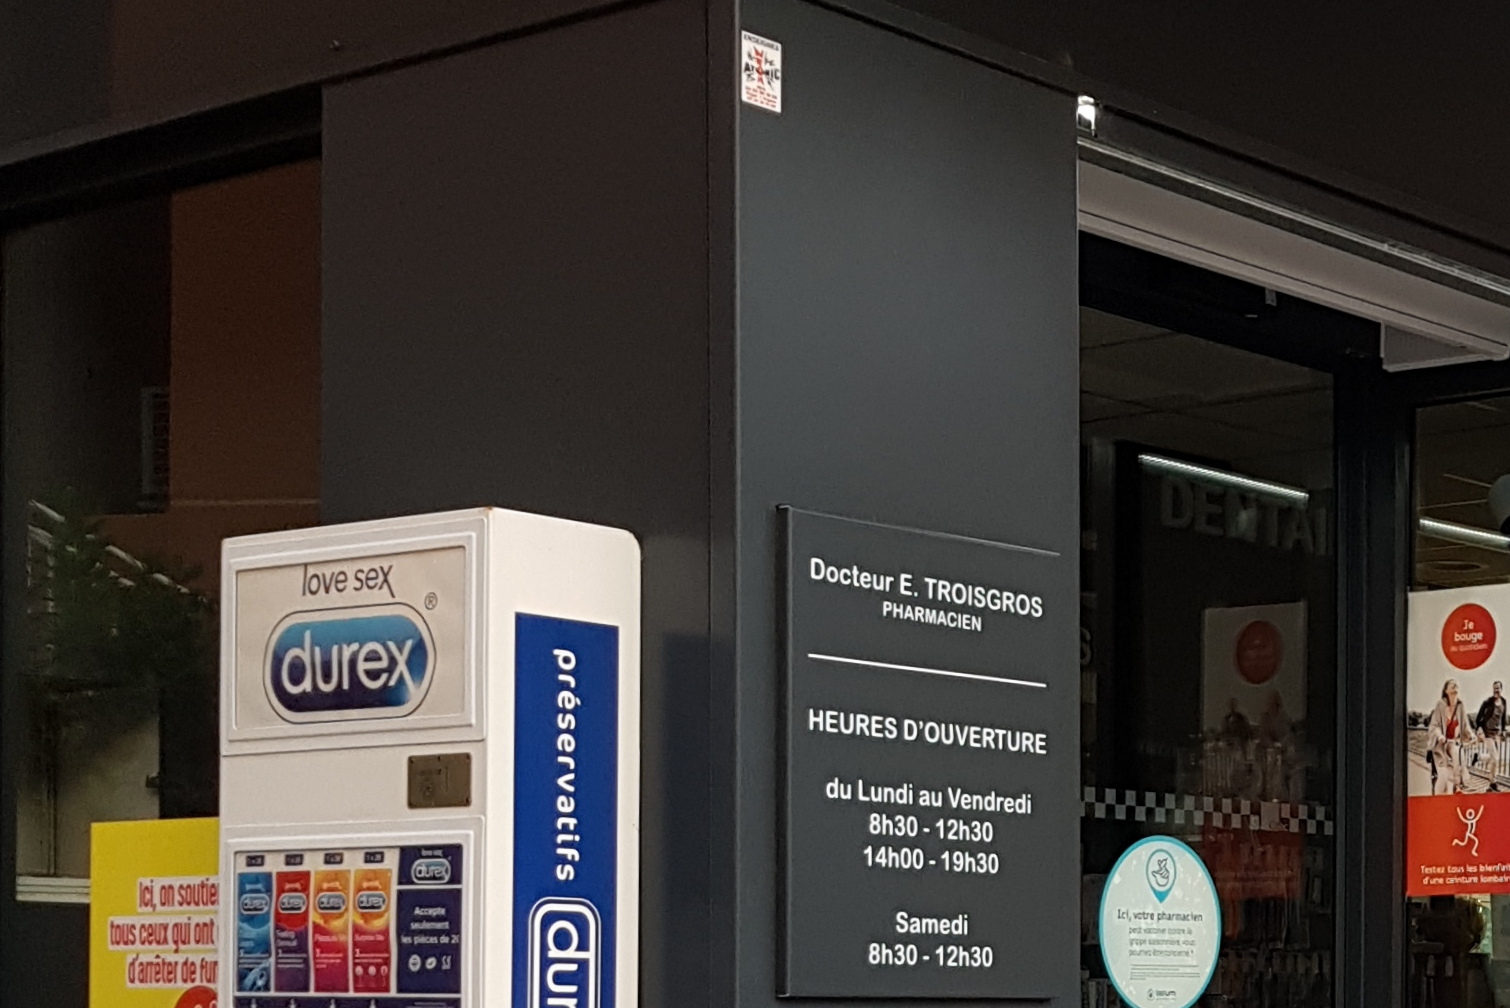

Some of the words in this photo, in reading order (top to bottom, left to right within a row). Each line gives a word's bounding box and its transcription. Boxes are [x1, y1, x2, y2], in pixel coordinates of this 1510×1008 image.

[302, 564, 347, 596] love
[354, 564, 396, 598] sex
[810, 557, 894, 592] Docteur
[900, 574, 918, 597] E.
[924, 577, 1043, 618] TROISGROS
[882, 601, 982, 632] PHARMACIEN
[1463, 619, 1474, 630] Je
[1454, 632, 1483, 643] bouge
[281, 629, 420, 695] durex
[809, 709, 897, 739] HEURES
[903, 719, 1047, 754] D'OUVERTURE
[552, 648, 580, 881] préservatifs
[826, 777, 851, 799] du
[858, 779, 913, 805] Lundi
[919, 789, 942, 807] au
[948, 787, 1032, 814] Vendredi
[869, 813, 918, 837] 8h30
[935, 818, 993, 842] 12h30
[415, 865, 449, 880] durex
[863, 845, 924, 870] 14h00
[941, 851, 1000, 874] 19h30
[1421, 865, 1445, 874] Testez
[1466, 864, 1477, 873] les
[139, 880, 156, 911] Ici,
[160, 885, 174, 907] on
[178, 878, 219, 906] soutie
[1423, 876, 1443, 884] d'une
[1446, 876, 1478, 884] ceinture
[411, 921, 449, 929] seulement
[414, 906, 446, 917] Accepte
[895, 911, 968, 935] Samedi
[1117, 909, 1132, 922] Ici,
[1133, 911, 1155, 921] votre
[1157, 910, 1203, 922] pharmacien
[110, 920, 136, 945] tous
[139, 922, 169, 945] ceux
[172, 917, 190, 953] qui
[194, 918, 214, 945] ont
[128, 954, 178, 983] d'arrêter
[182, 956, 196, 982] de
[868, 943, 918, 965] 8h30
[935, 946, 993, 967] 12h30
